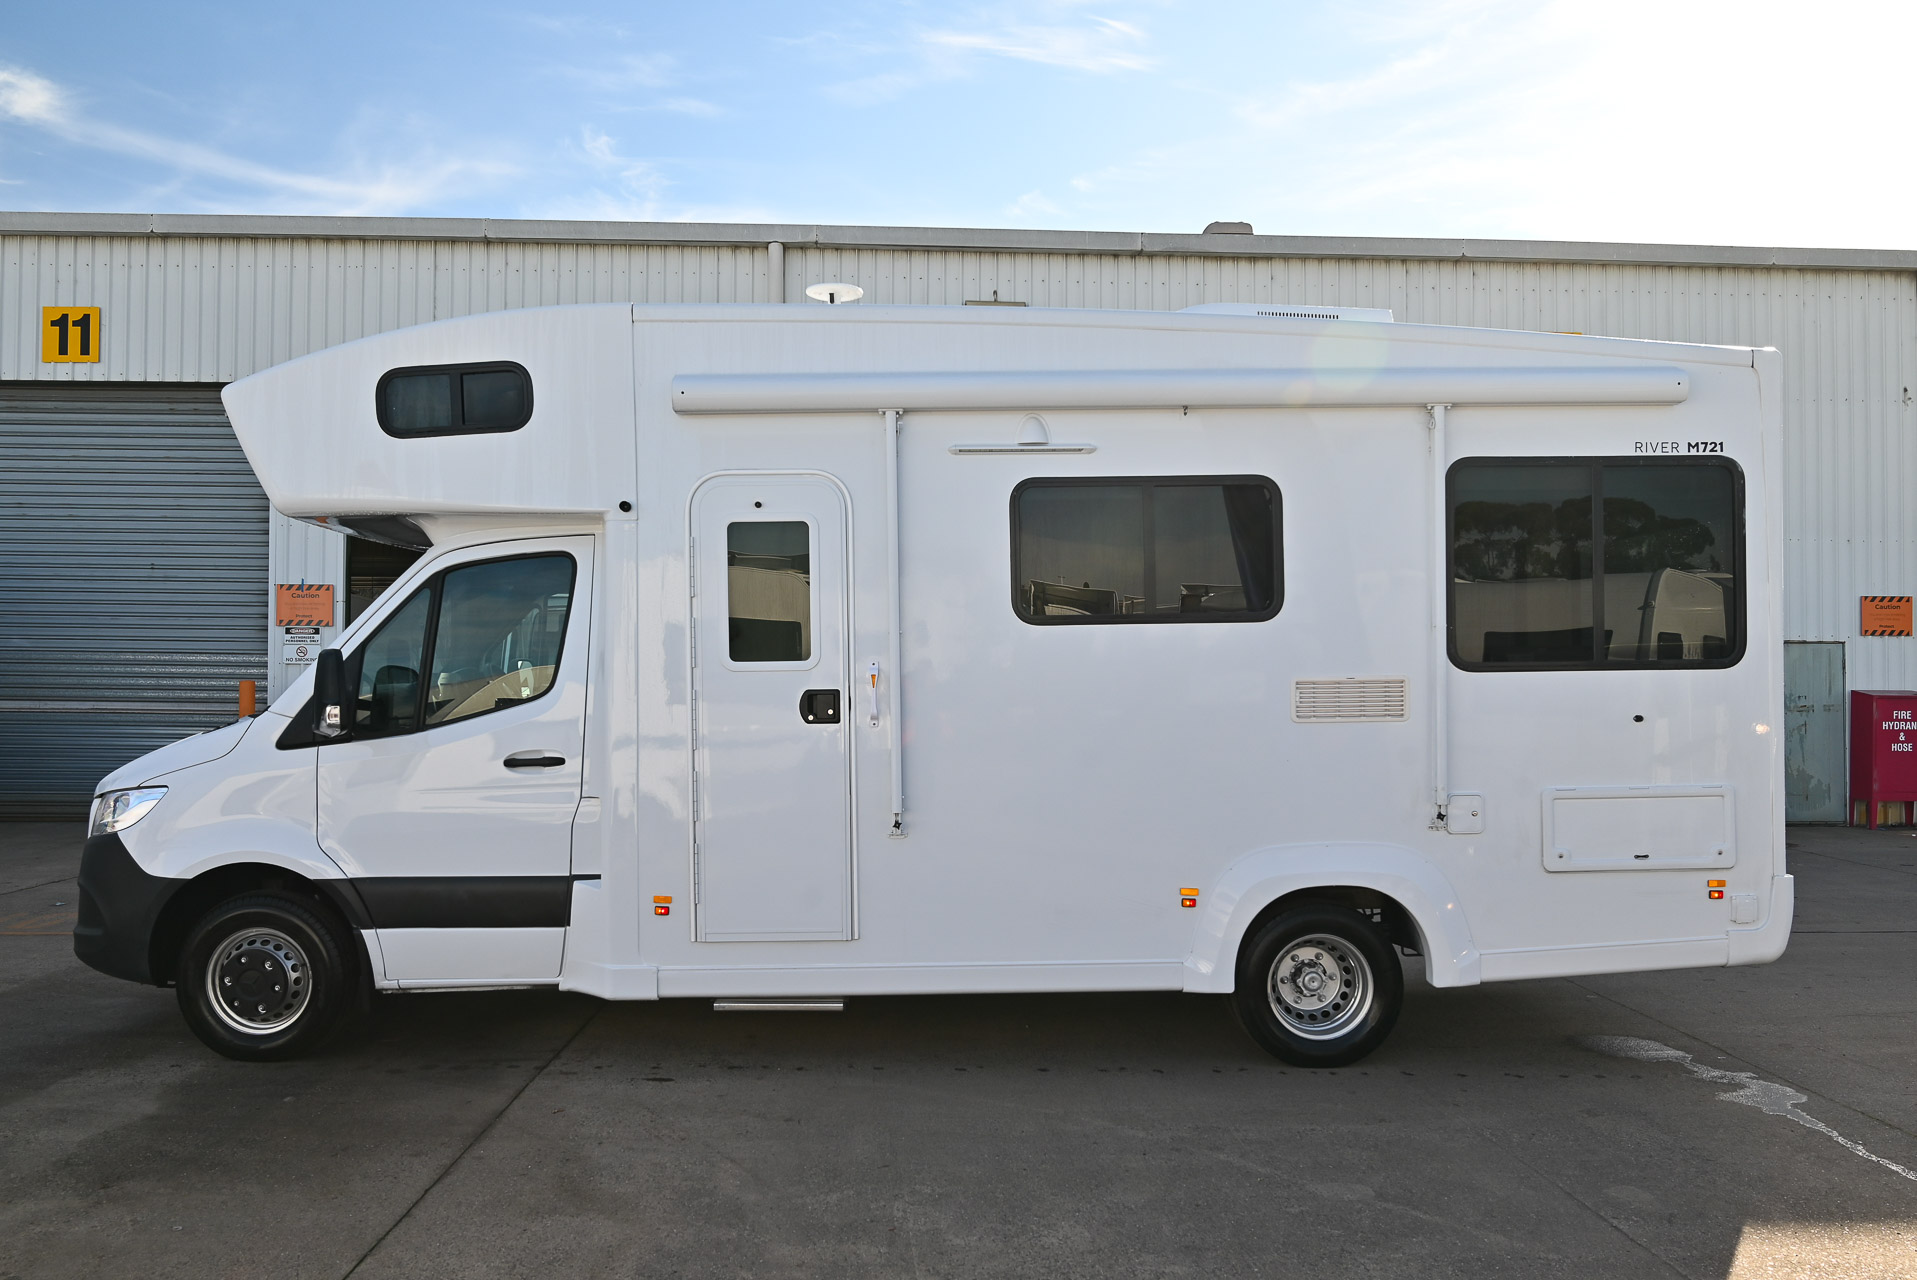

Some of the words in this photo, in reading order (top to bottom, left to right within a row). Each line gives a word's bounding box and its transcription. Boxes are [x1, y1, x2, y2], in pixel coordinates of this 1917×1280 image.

[50, 313, 91, 356] 11
[1634, 441, 1680, 453] RIVER
[1687, 441, 1724, 453] M721
[1893, 710, 1912, 720] FIRE
[1882, 721, 1917, 730] HYDRAN
[1899, 732, 1906, 741] &
[1891, 743, 1913, 752] HOSE
